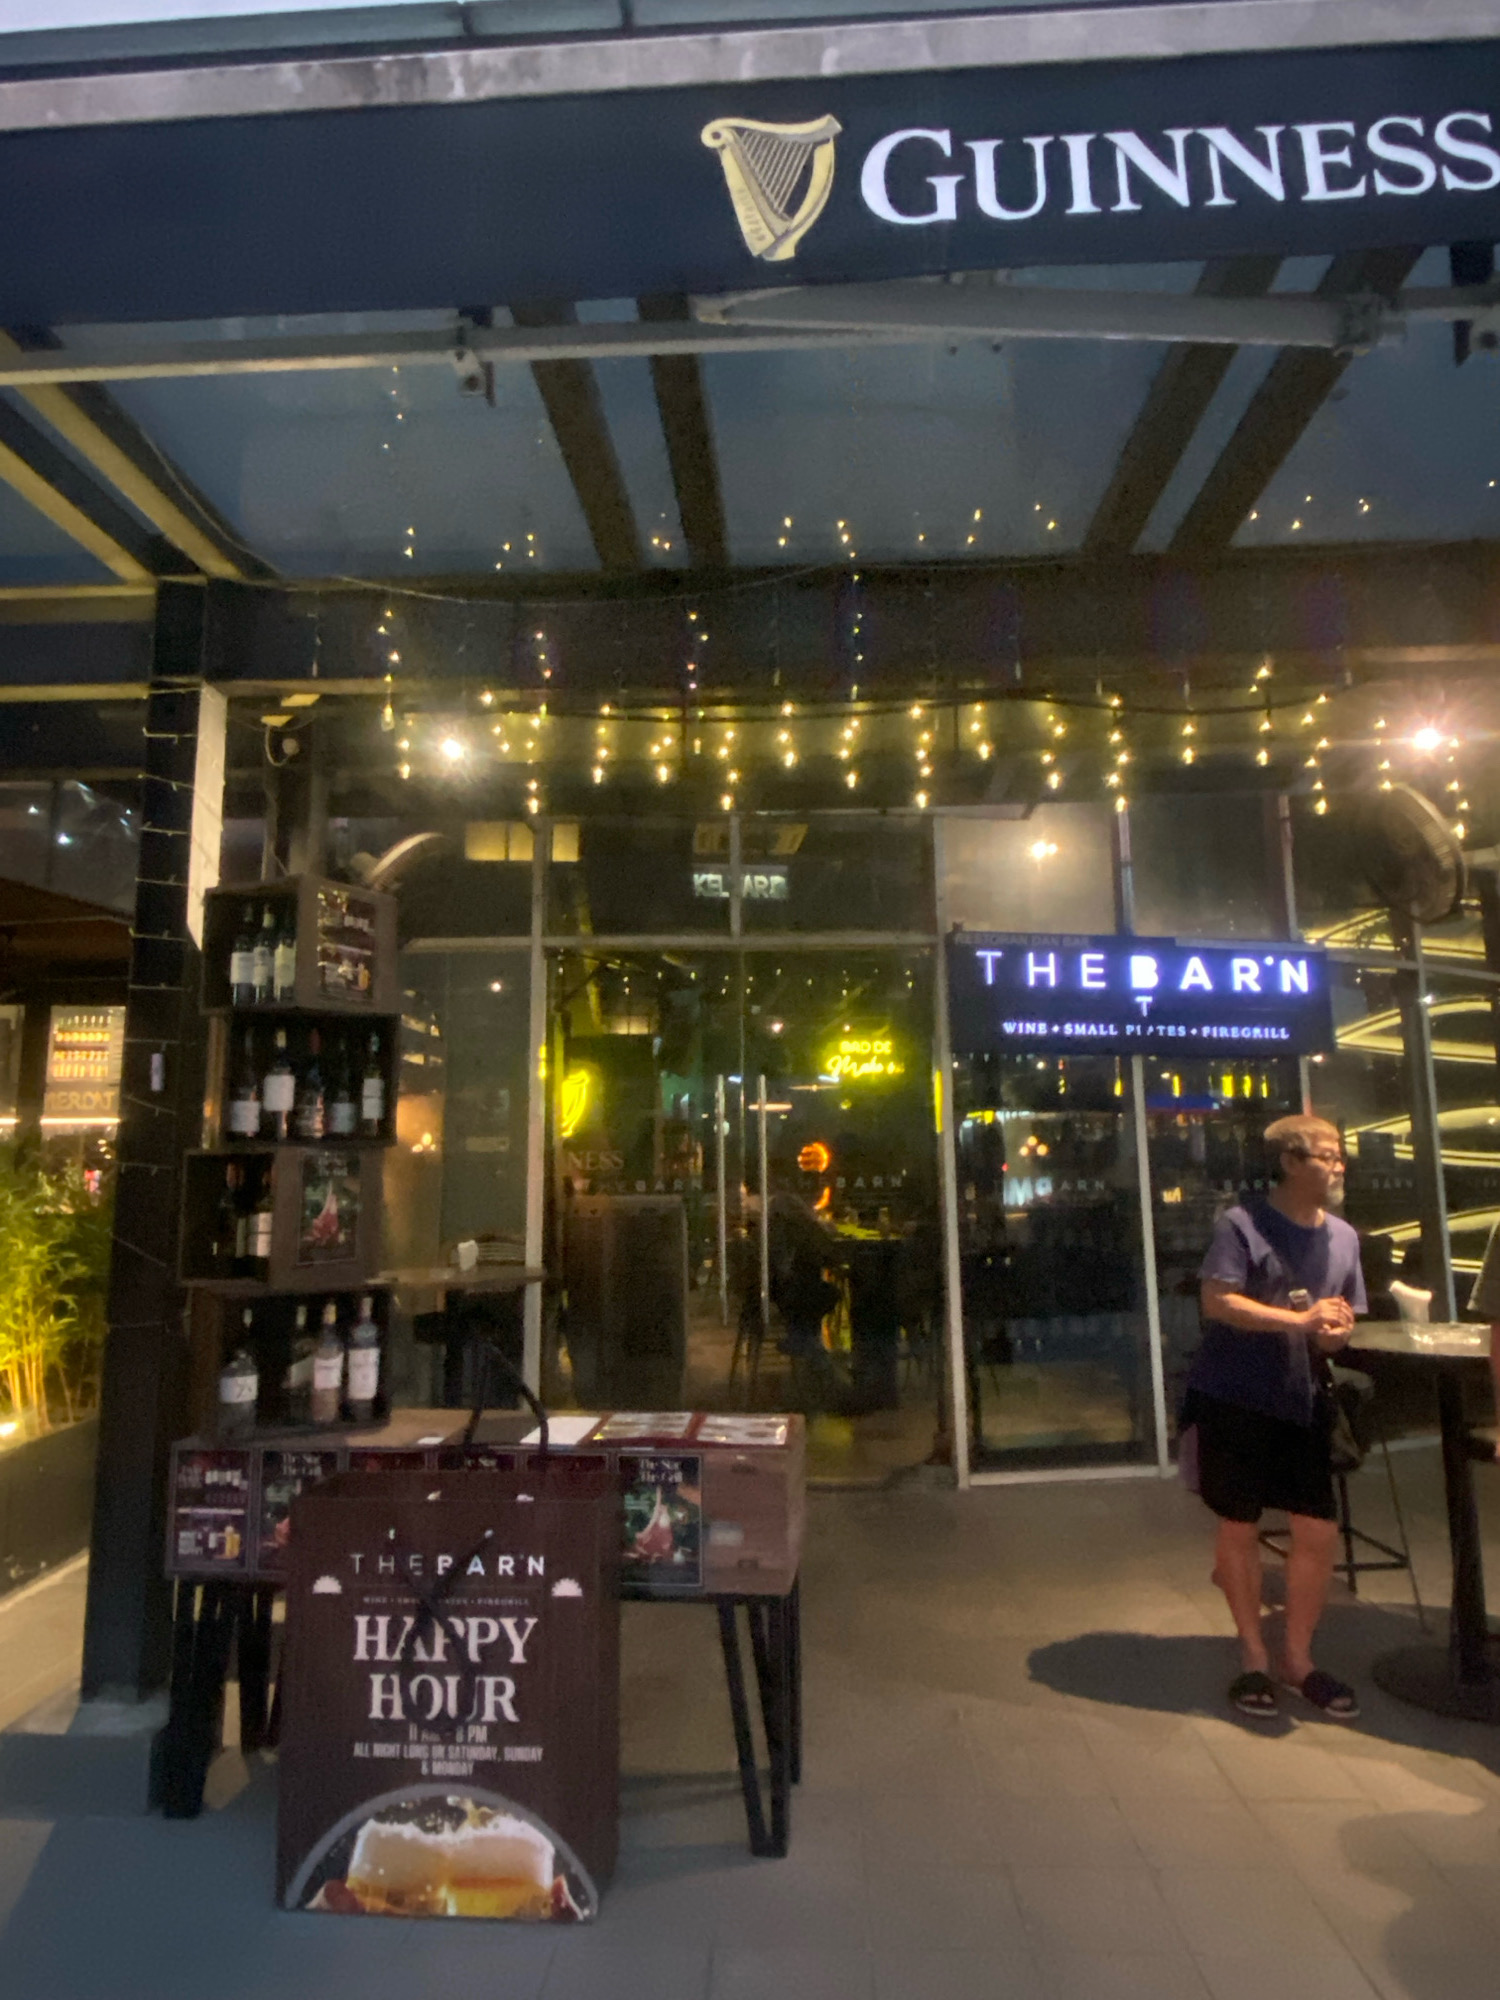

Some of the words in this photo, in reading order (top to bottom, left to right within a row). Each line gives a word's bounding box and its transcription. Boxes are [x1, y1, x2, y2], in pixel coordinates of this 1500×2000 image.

[860, 112, 1500, 225] GUINNESS
[693, 873, 770, 899] KELAR
[975, 951, 1107, 989] THE
[1002, 1021, 1047, 1036] WINE
[1064, 1023, 1118, 1037] SMALL
[1201, 1026, 1290, 1041] FIREGRILL
[351, 1554, 424, 1576] THE
[353, 1615, 539, 1664] HAPPY
[368, 1673, 520, 1723] HOUR
[467, 1725, 488, 1743] PM
[432, 1761, 474, 1776] MONDAY
